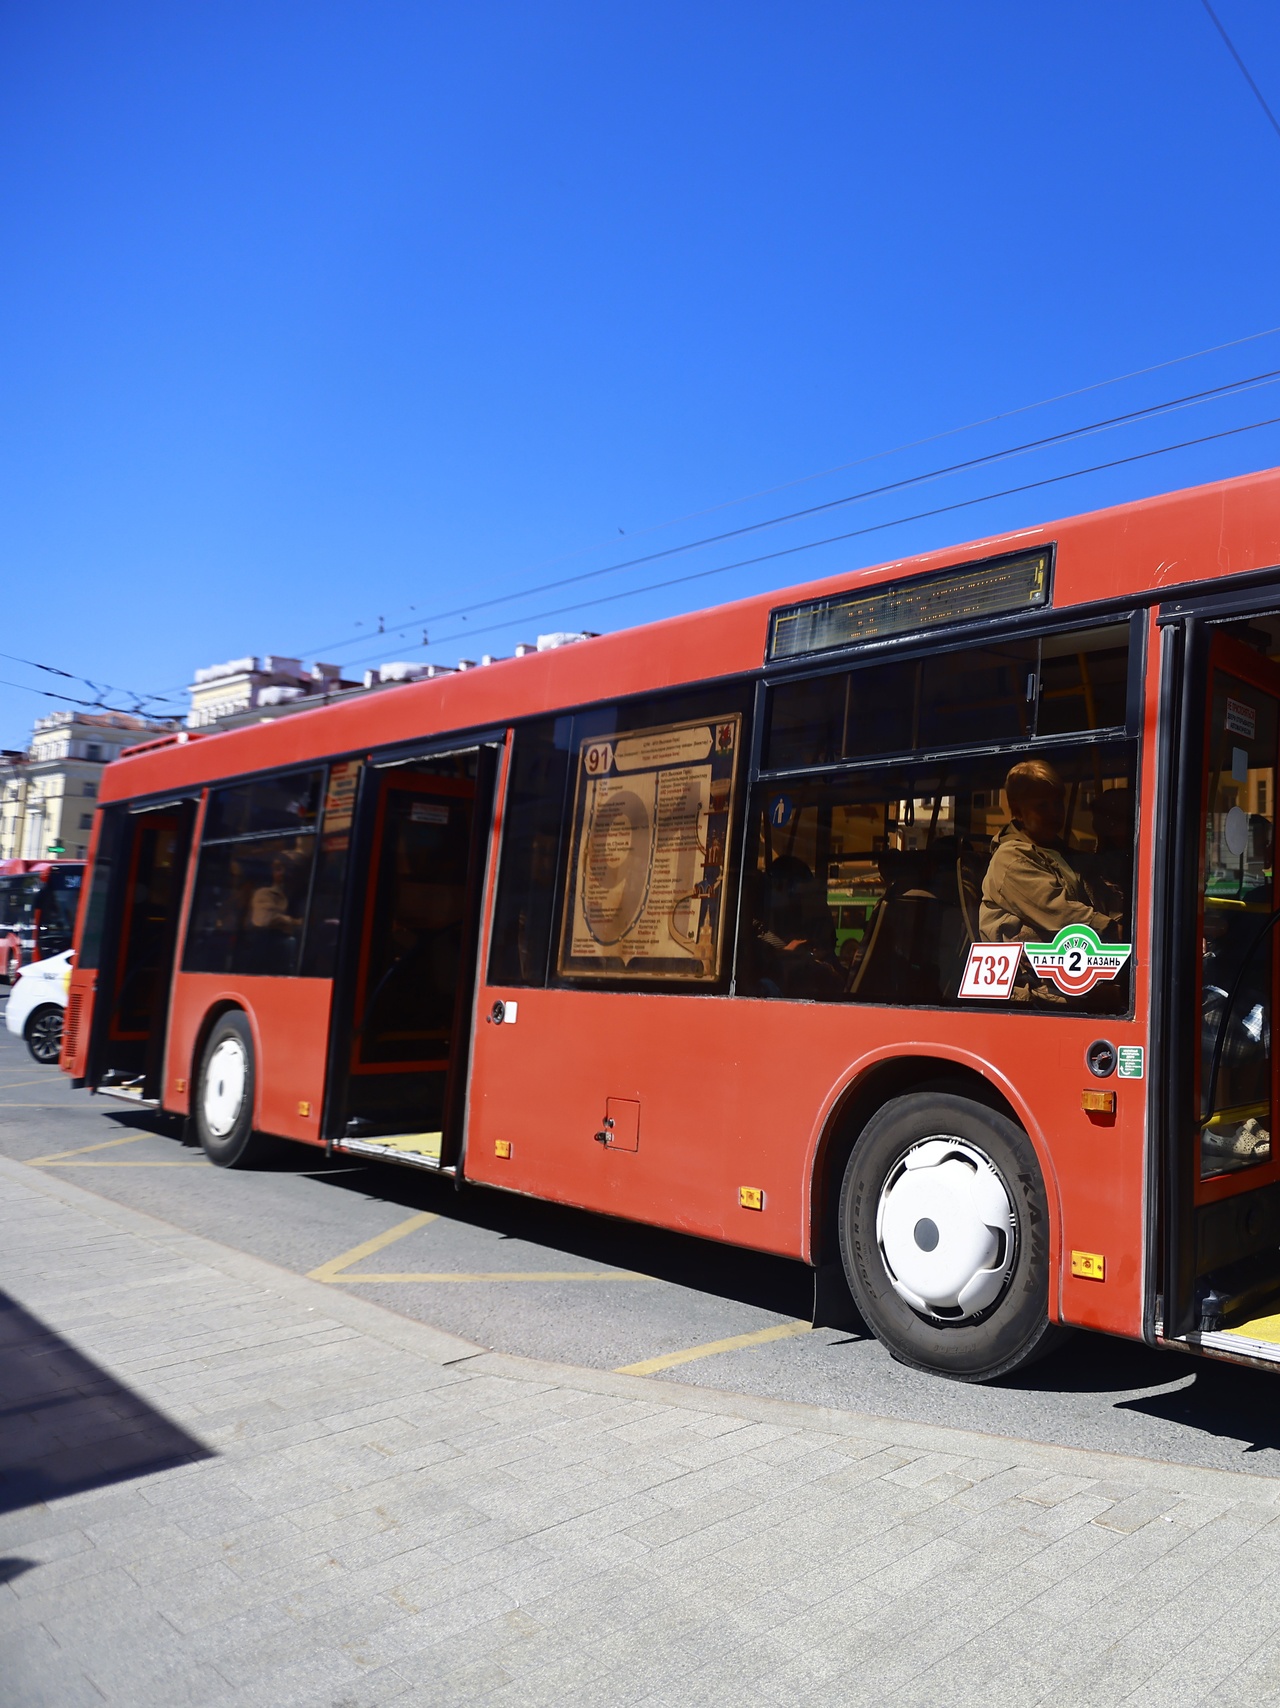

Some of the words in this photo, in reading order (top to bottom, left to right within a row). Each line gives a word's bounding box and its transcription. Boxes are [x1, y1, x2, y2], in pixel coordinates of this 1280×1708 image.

[588, 746, 608, 772] 91
[1063, 938, 1089, 952] МУП
[971, 955, 1011, 986] 732
[1033, 956, 1064, 965] ПАТП
[1069, 952, 1082, 972] 2
[1087, 956, 1121, 966] КАЗАНЬ
